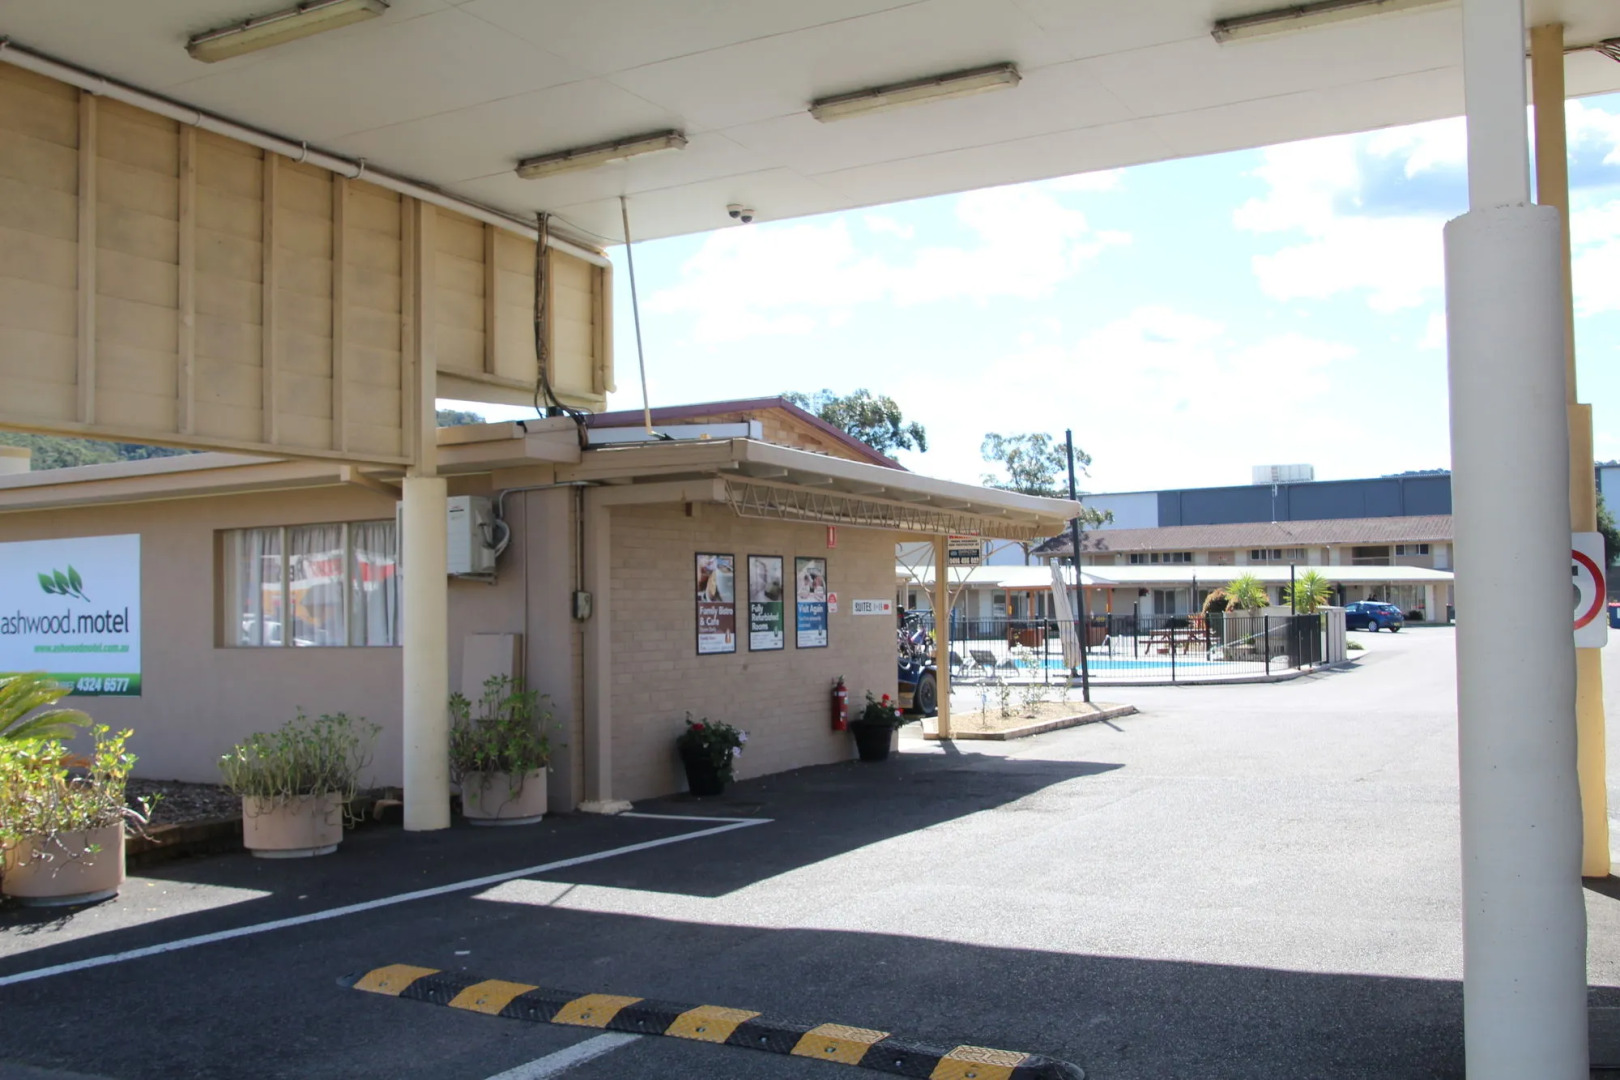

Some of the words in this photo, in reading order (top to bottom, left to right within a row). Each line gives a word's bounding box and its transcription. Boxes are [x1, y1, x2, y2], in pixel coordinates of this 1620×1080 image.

[752, 604, 763, 614] Fully
[798, 604, 809, 613] Visit
[810, 604, 824, 615] Again
[855, 602, 872, 612] SUITES
[699, 606, 717, 619] Family
[719, 606, 733, 615] Bistro
[752, 612, 779, 621] Refurbished
[1, 607, 129, 635] ashwood.motel
[699, 617, 705, 626] &
[752, 622, 768, 631] Rooms
[76, 677, 102, 692] 4324
[103, 677, 129, 692] 6577
